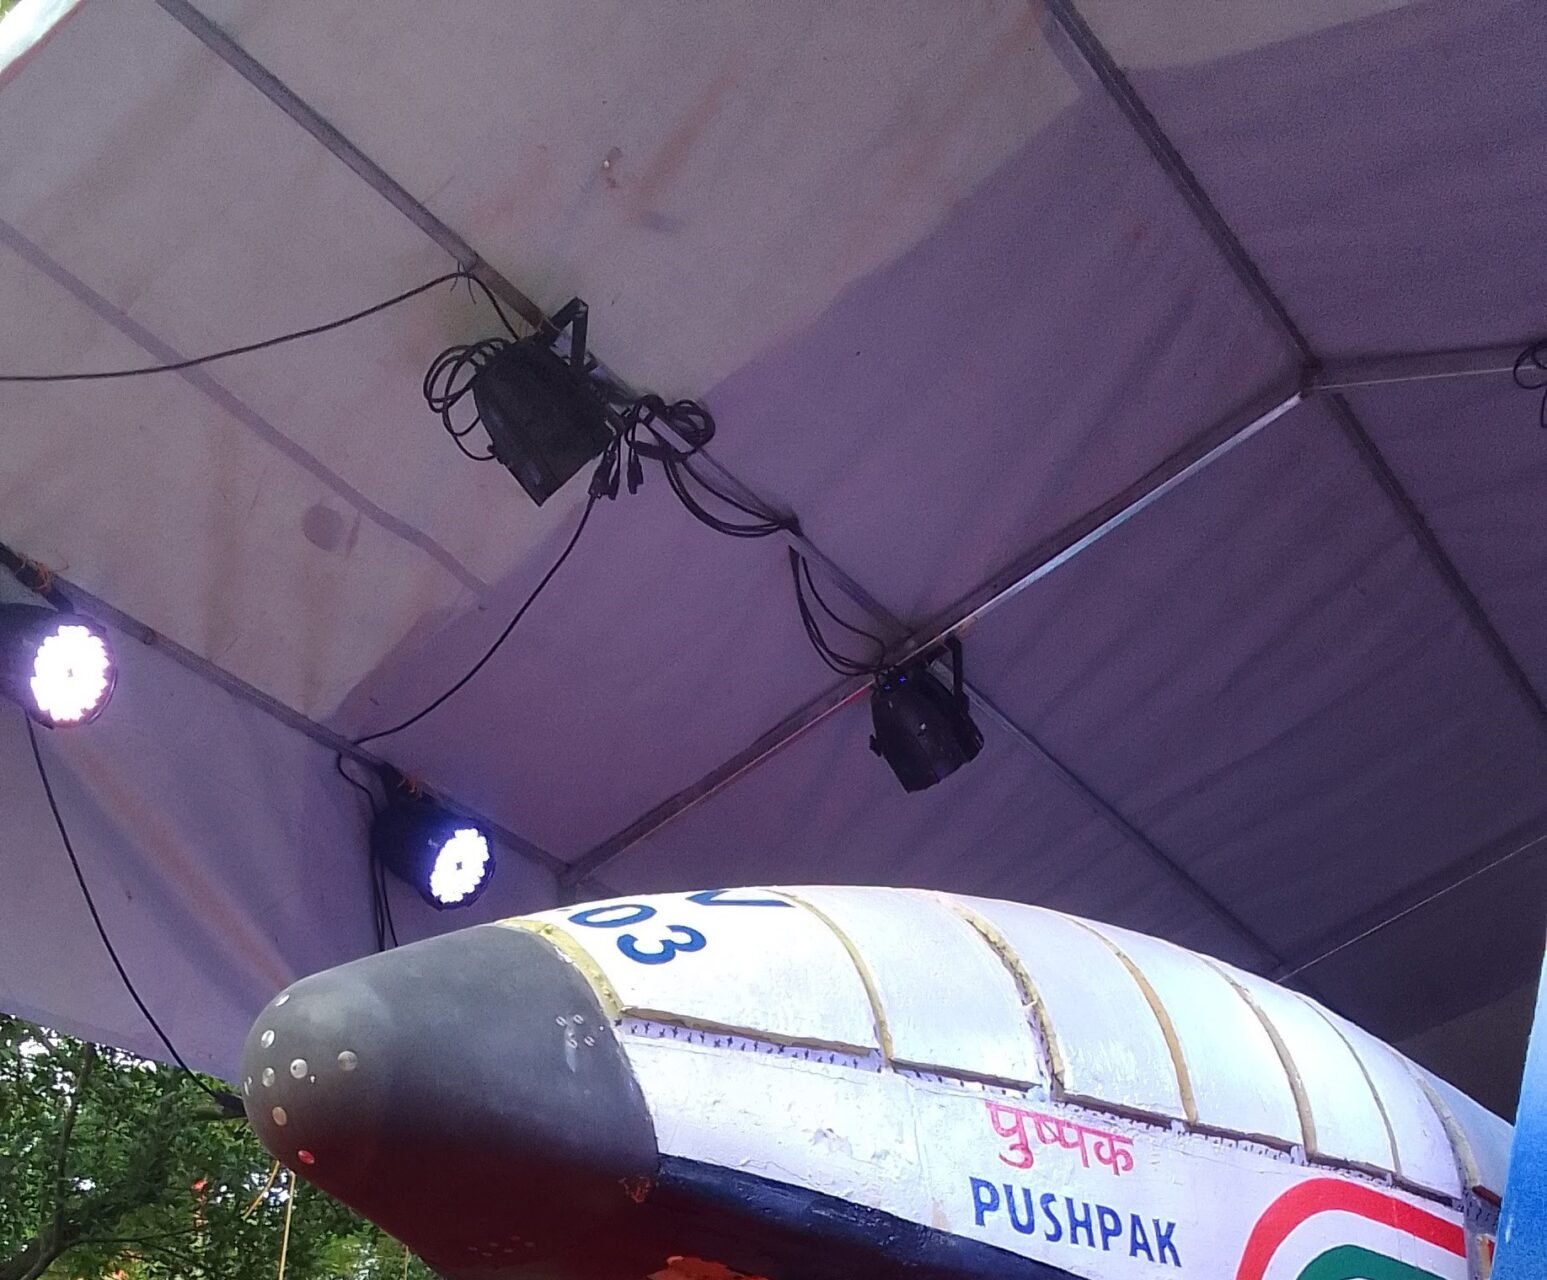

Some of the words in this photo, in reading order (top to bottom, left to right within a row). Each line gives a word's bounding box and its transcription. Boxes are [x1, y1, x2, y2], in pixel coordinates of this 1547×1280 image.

[567, 904, 707, 965] 03
[985, 1102, 1134, 1176] पुष्पक
[969, 1176, 1182, 1268] PUSHPAK
